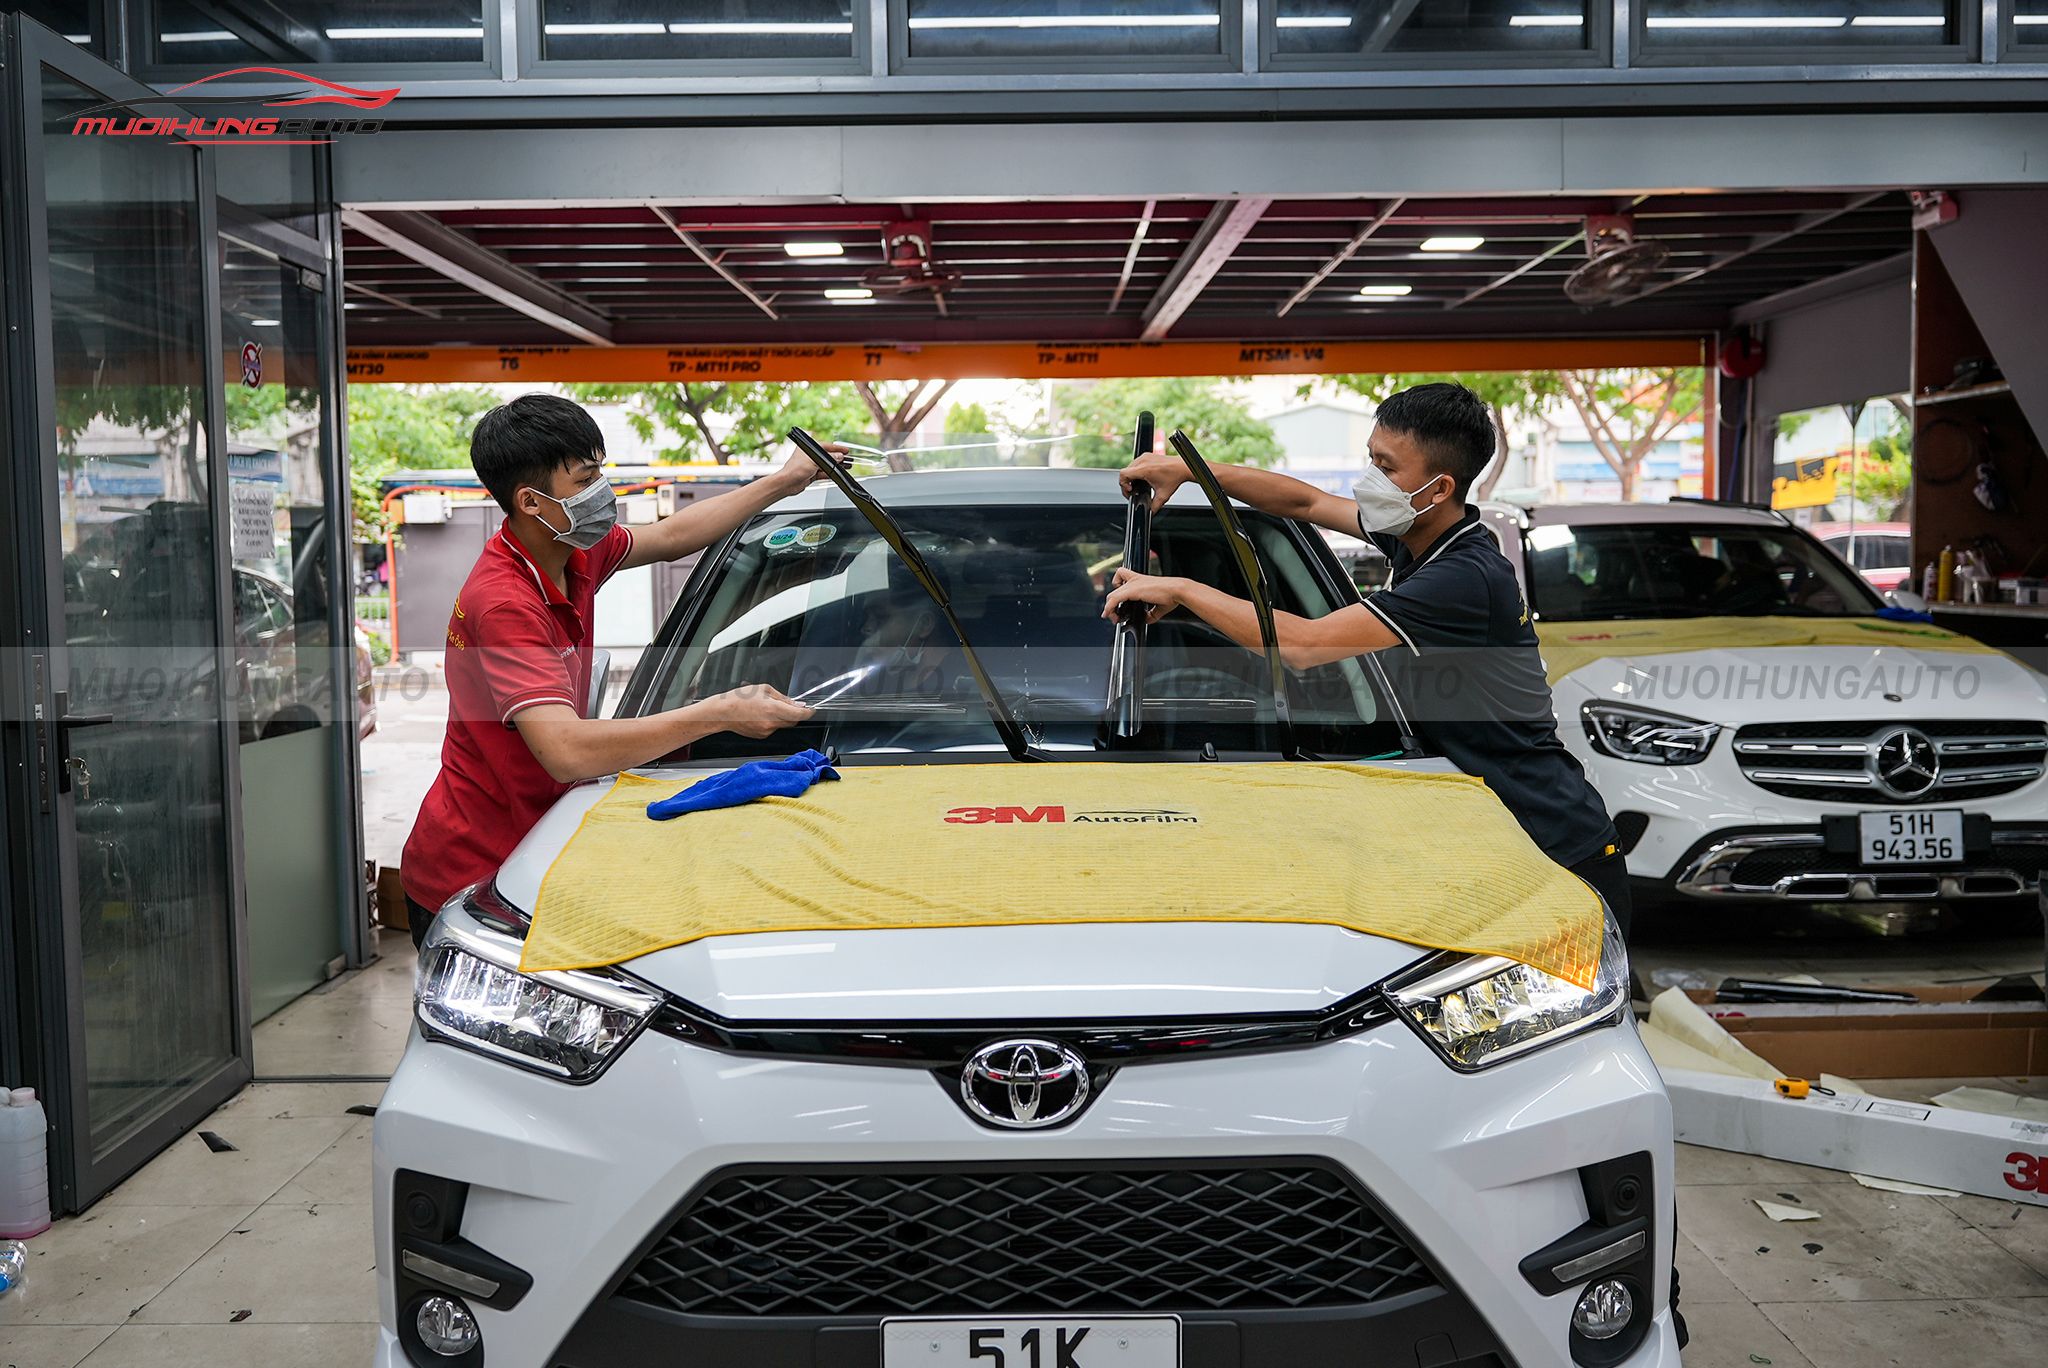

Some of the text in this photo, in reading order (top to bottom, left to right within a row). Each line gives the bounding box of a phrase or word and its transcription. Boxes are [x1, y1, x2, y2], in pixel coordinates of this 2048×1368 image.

[864, 353, 882, 366] T1
[1038, 352, 1056, 364] TP
[1239, 348, 1291, 362] MTSM
[500, 356, 519, 371] T6
[669, 361, 686, 373] TP
[731, 361, 761, 373] PRO
[943, 805, 1198, 824] 3M AutoFilm
[1889, 813, 1934, 835] 51H
[1872, 837, 1953, 861] 943.56
[969, 1327, 1092, 1368] 51K
